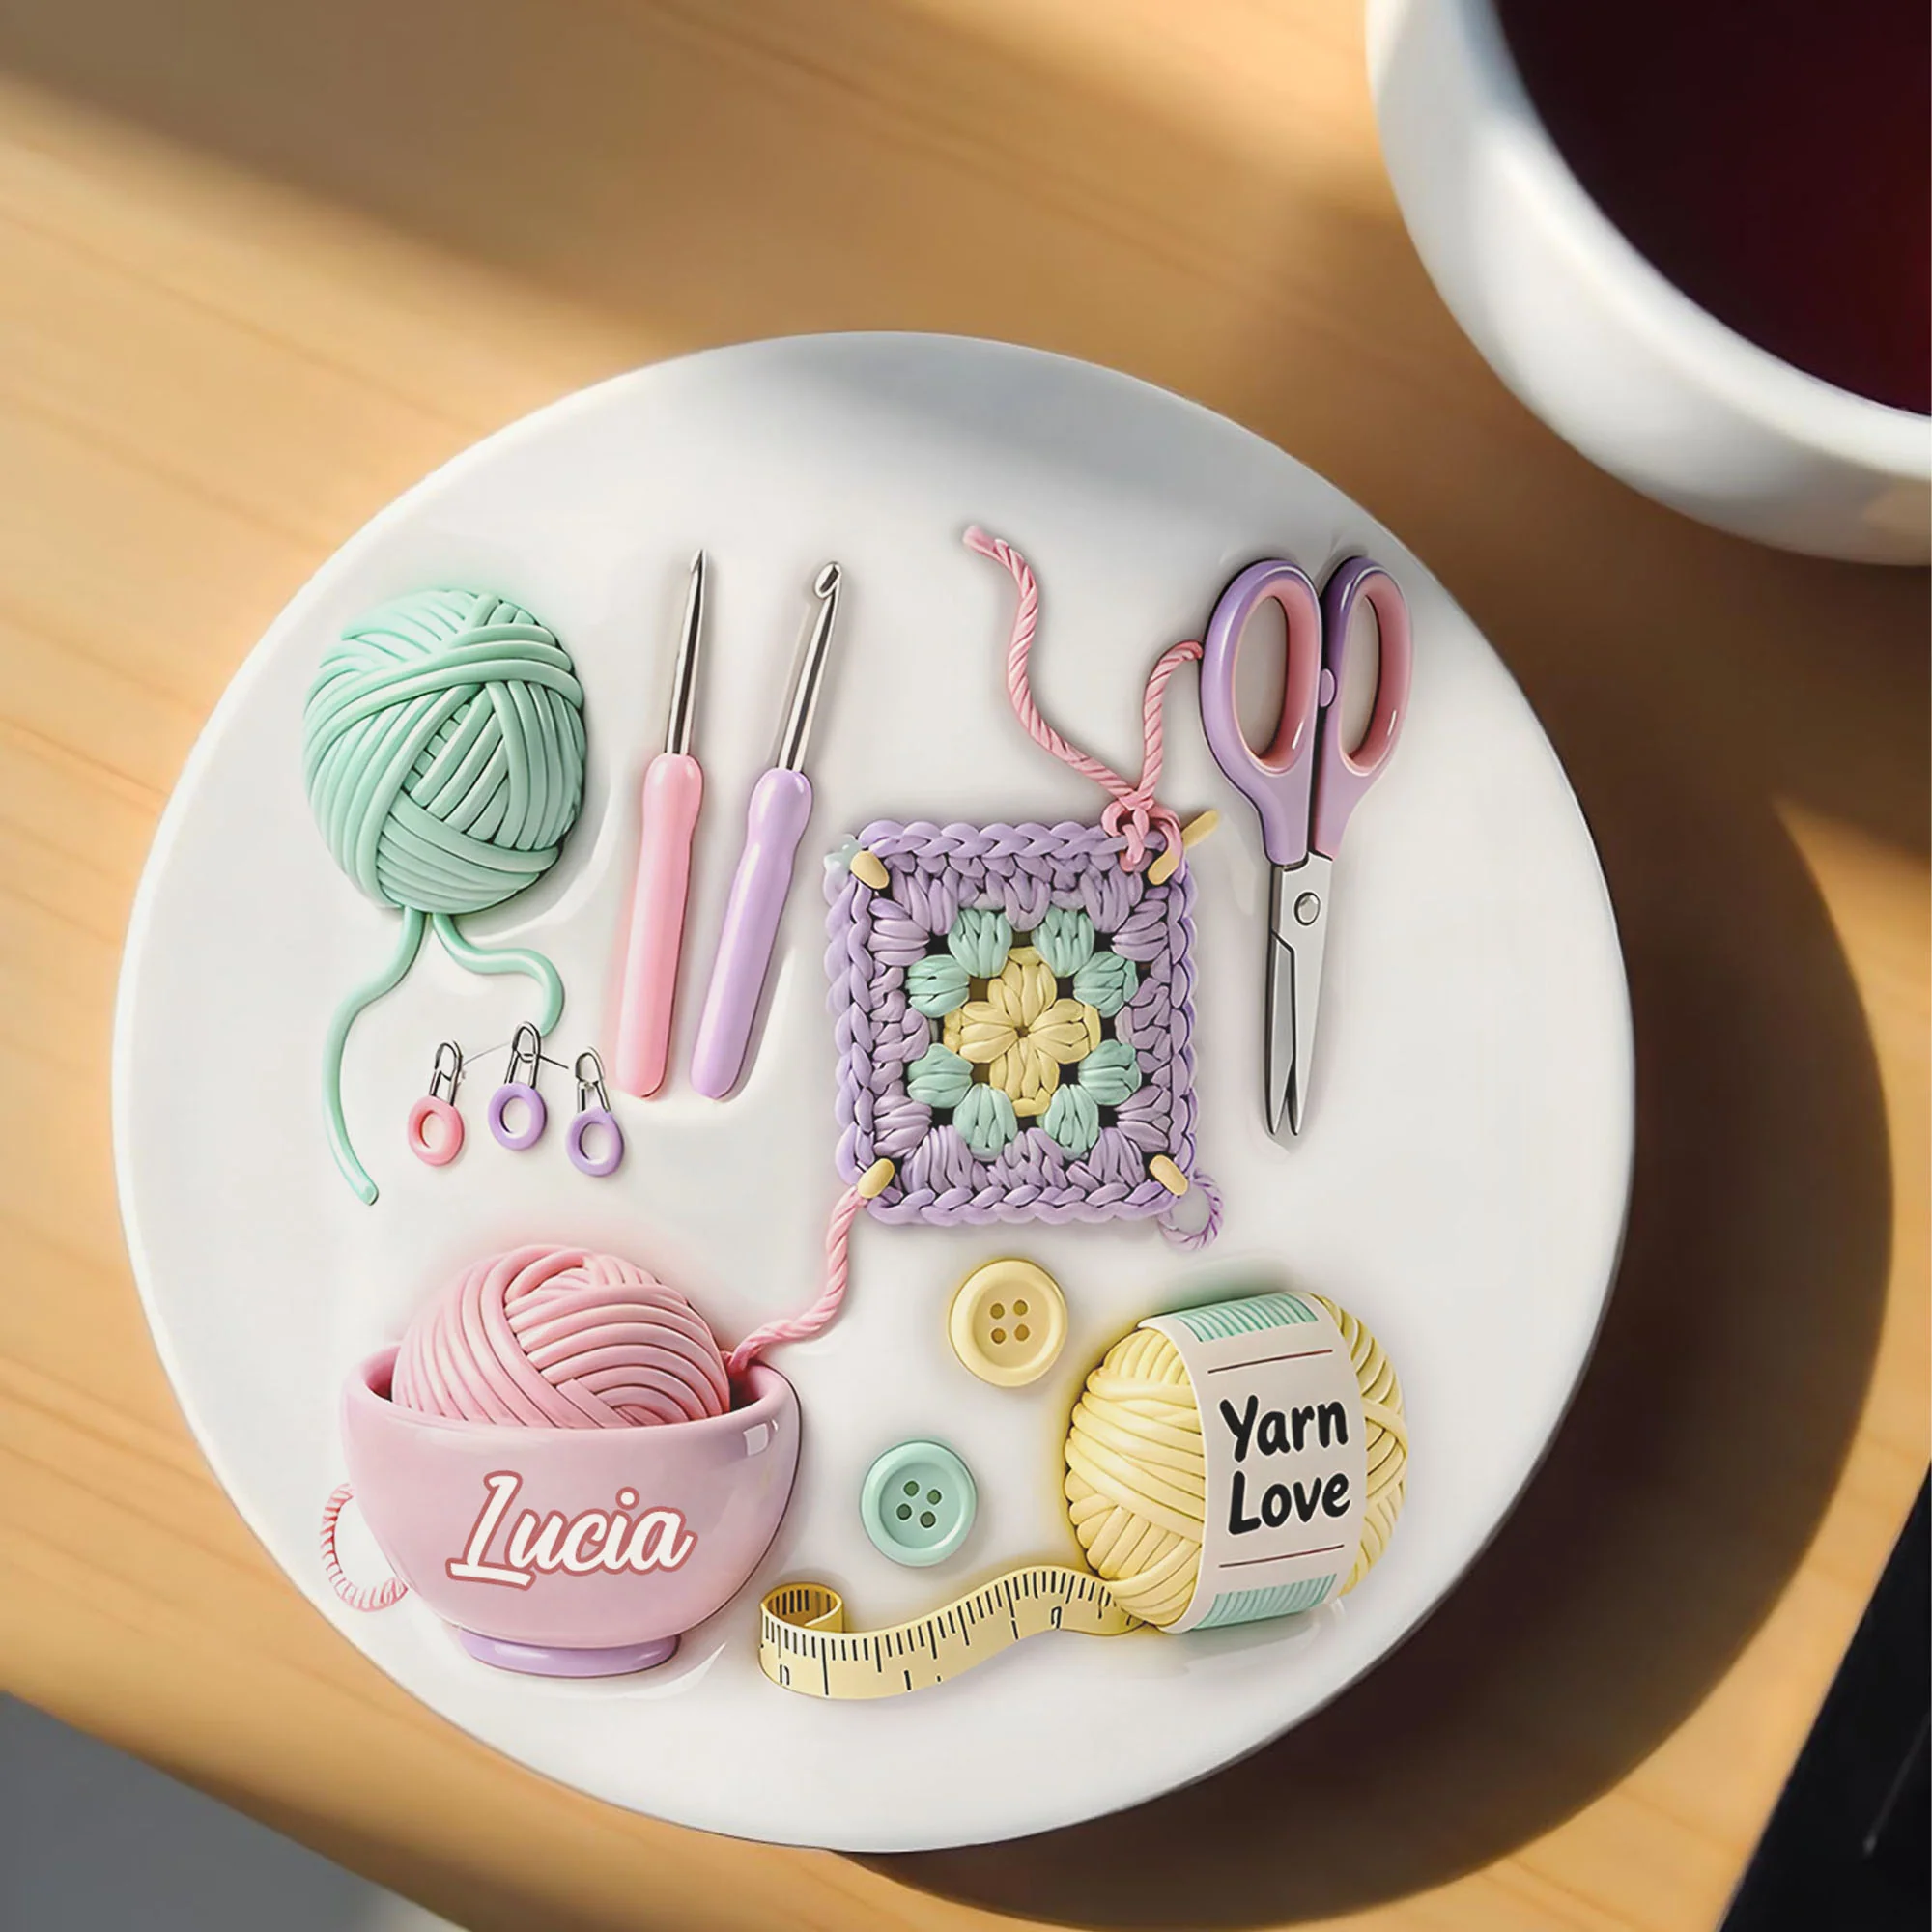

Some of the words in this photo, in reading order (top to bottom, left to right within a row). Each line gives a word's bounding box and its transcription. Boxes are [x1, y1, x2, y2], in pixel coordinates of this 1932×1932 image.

[1219, 1395, 1349, 1462] Yarn
[445, 1470, 697, 1591] Lucia
[1228, 1471, 1350, 1535] Love
